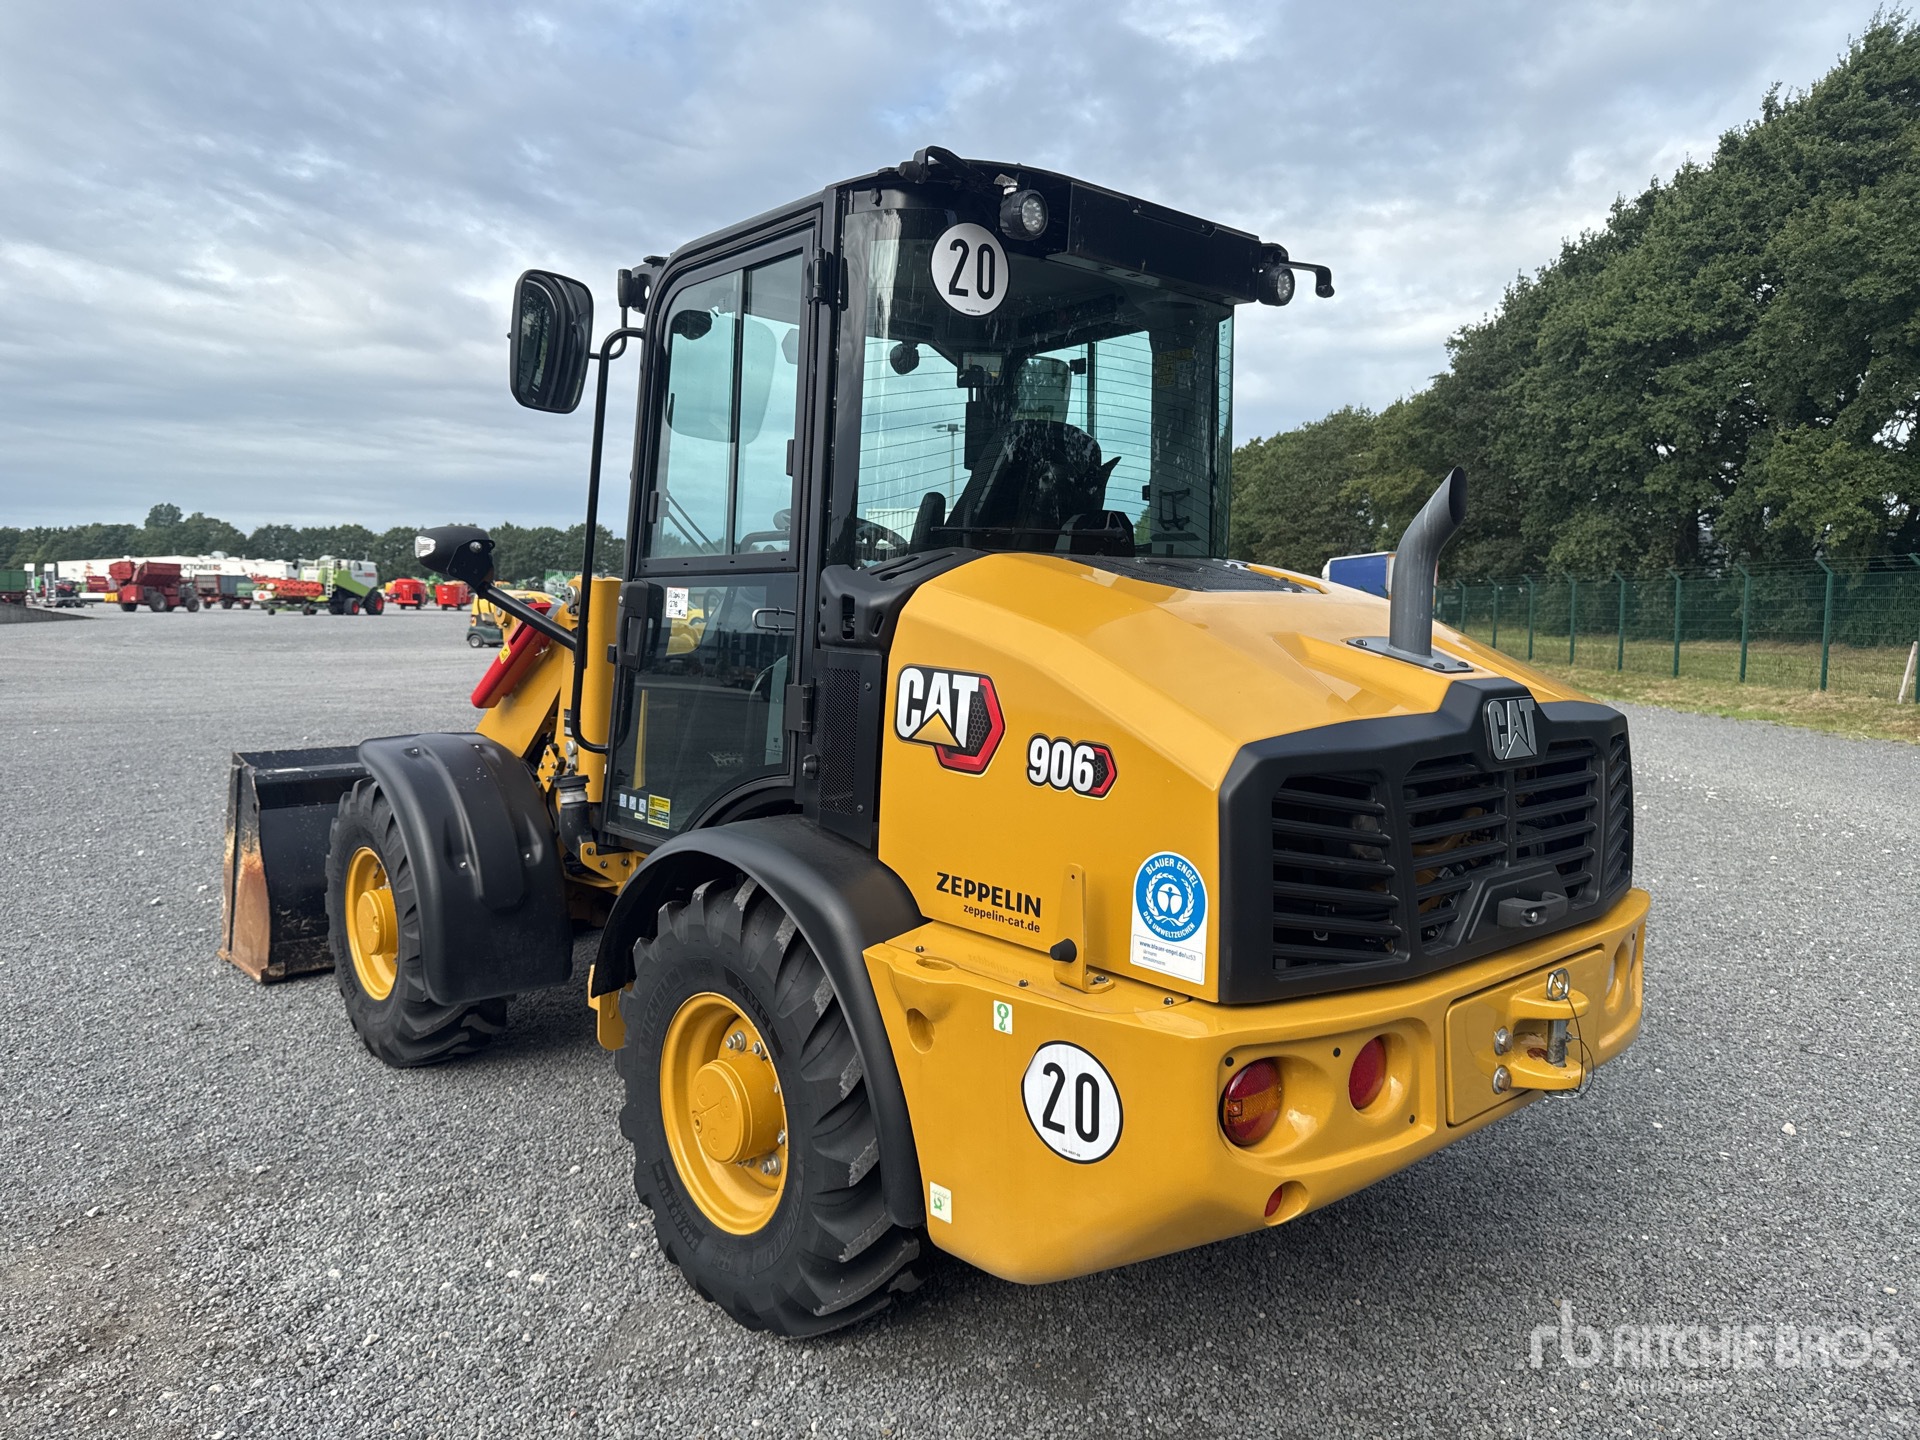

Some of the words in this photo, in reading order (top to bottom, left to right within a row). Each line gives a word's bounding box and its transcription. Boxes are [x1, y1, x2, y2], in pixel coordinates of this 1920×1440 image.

[948, 238, 996, 300] 20
[896, 666, 980, 749] CAT
[1487, 698, 1538, 760] CAT
[1028, 736, 1096, 792] 906
[936, 871, 1042, 918] ZEPPELIN
[1145, 857, 1175, 876] BLAUER
[1176, 861, 1199, 889] ENGEL
[963, 904, 1041, 934] zeppelin-cat.de
[1142, 910, 1153, 926] DAS
[1151, 921, 1196, 939] UMWELTZEICHEN
[1042, 1062, 1100, 1143] 20
